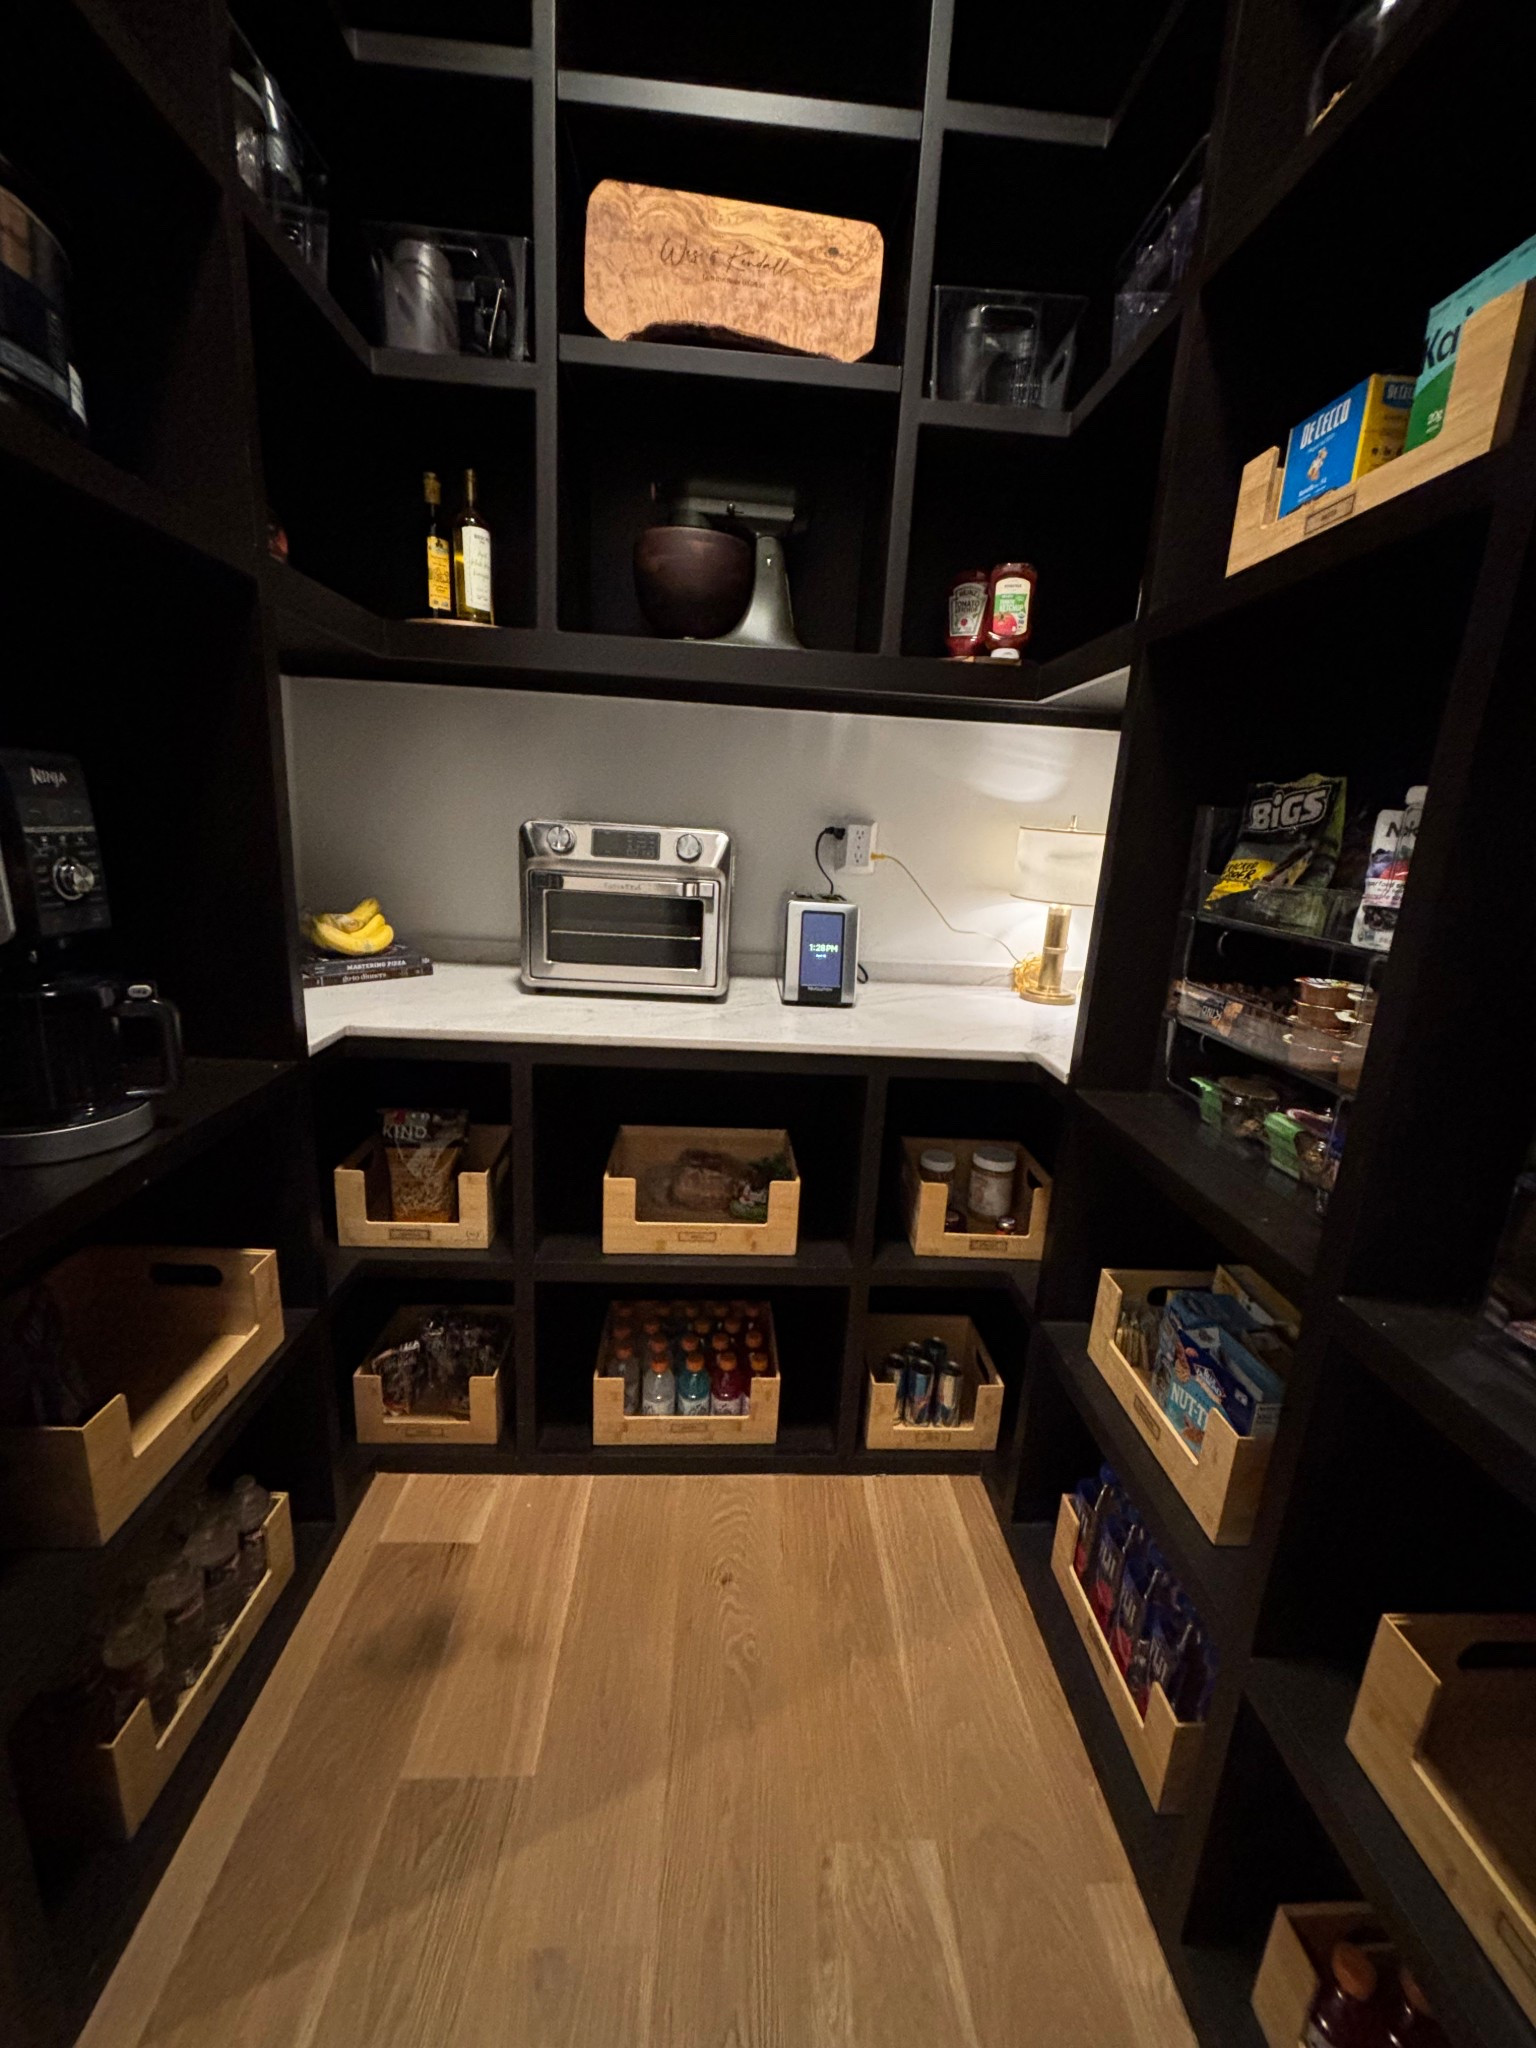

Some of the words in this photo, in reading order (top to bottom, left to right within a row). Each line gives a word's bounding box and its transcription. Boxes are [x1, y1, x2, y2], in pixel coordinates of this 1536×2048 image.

[660, 237, 698, 267] Wes
[725, 245, 800, 277] Kendall
[30, 767, 67, 787] NINJA
[346, 962, 387, 971] MASTERING
[387, 959, 407, 967] PIZZA
[382, 1124, 428, 1140] KIND
